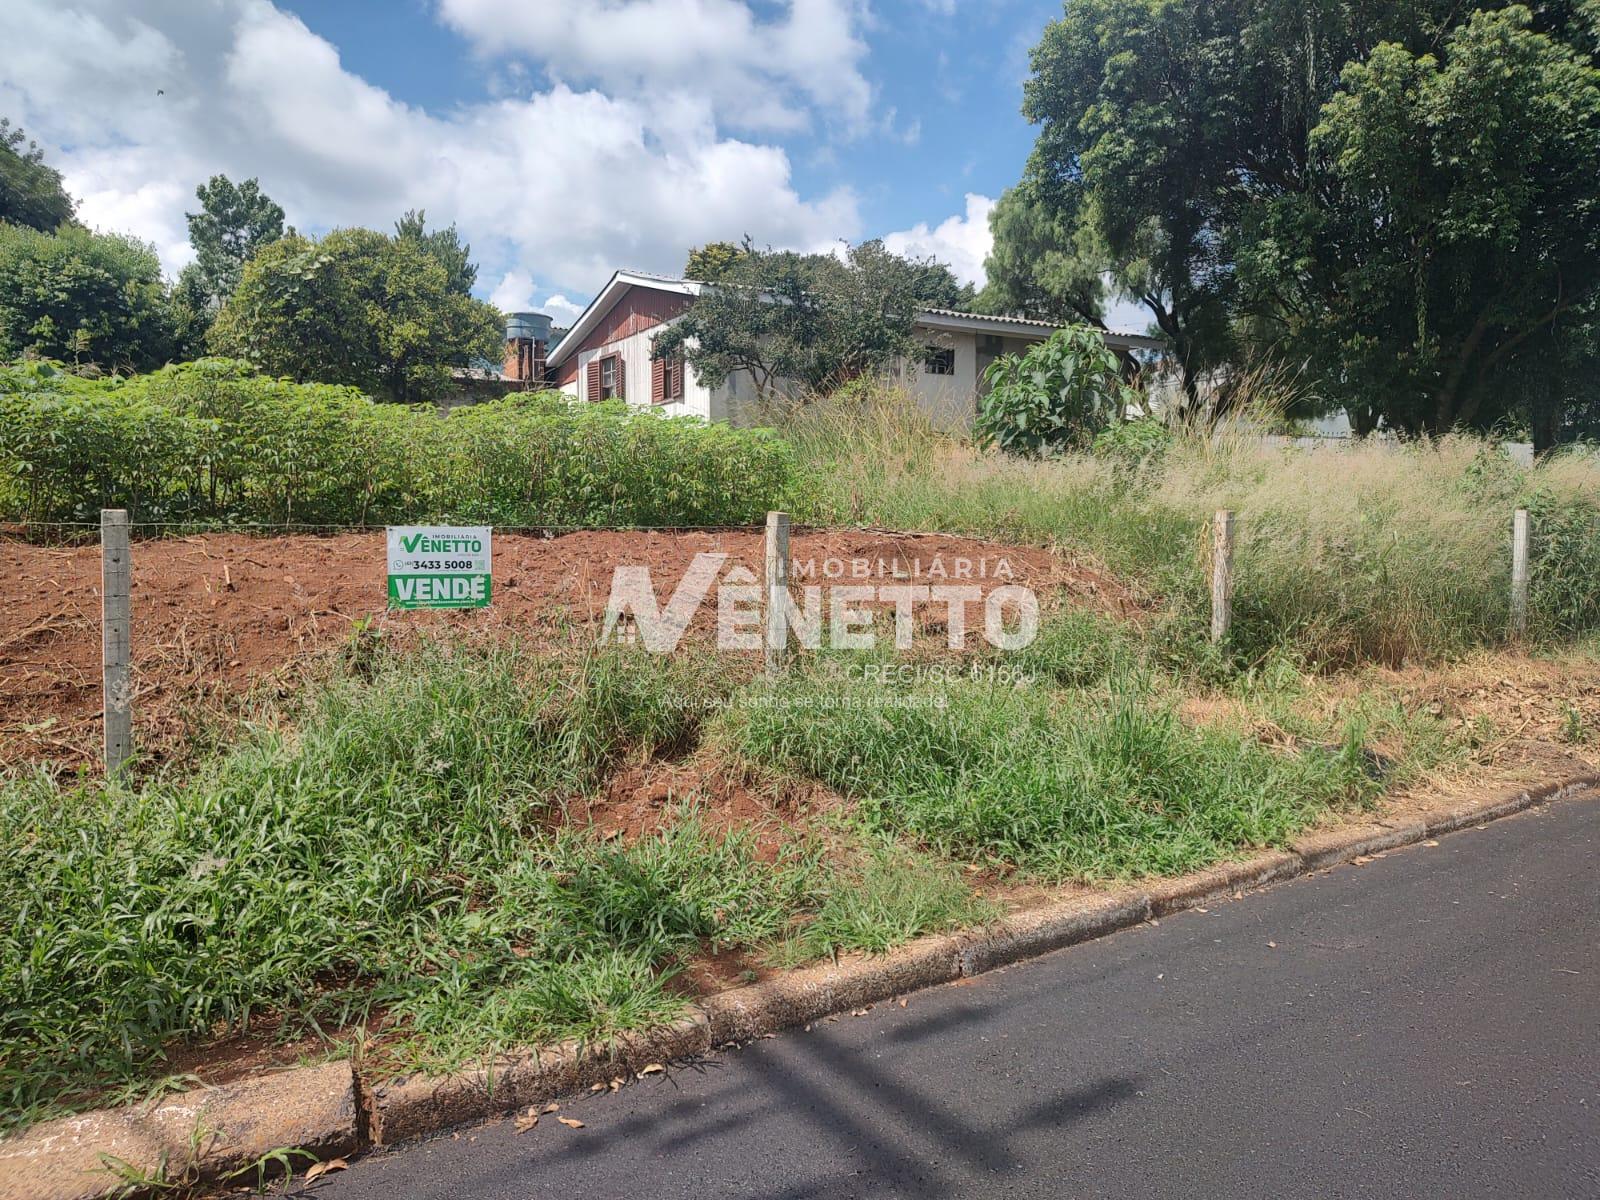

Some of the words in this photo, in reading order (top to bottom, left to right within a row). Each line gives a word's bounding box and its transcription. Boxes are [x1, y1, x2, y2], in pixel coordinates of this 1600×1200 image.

[400, 533, 482, 553] VÊNETTO
[413, 560, 441, 570] 3433
[444, 560, 473, 570] 5008
[395, 578, 485, 600] VENDE
